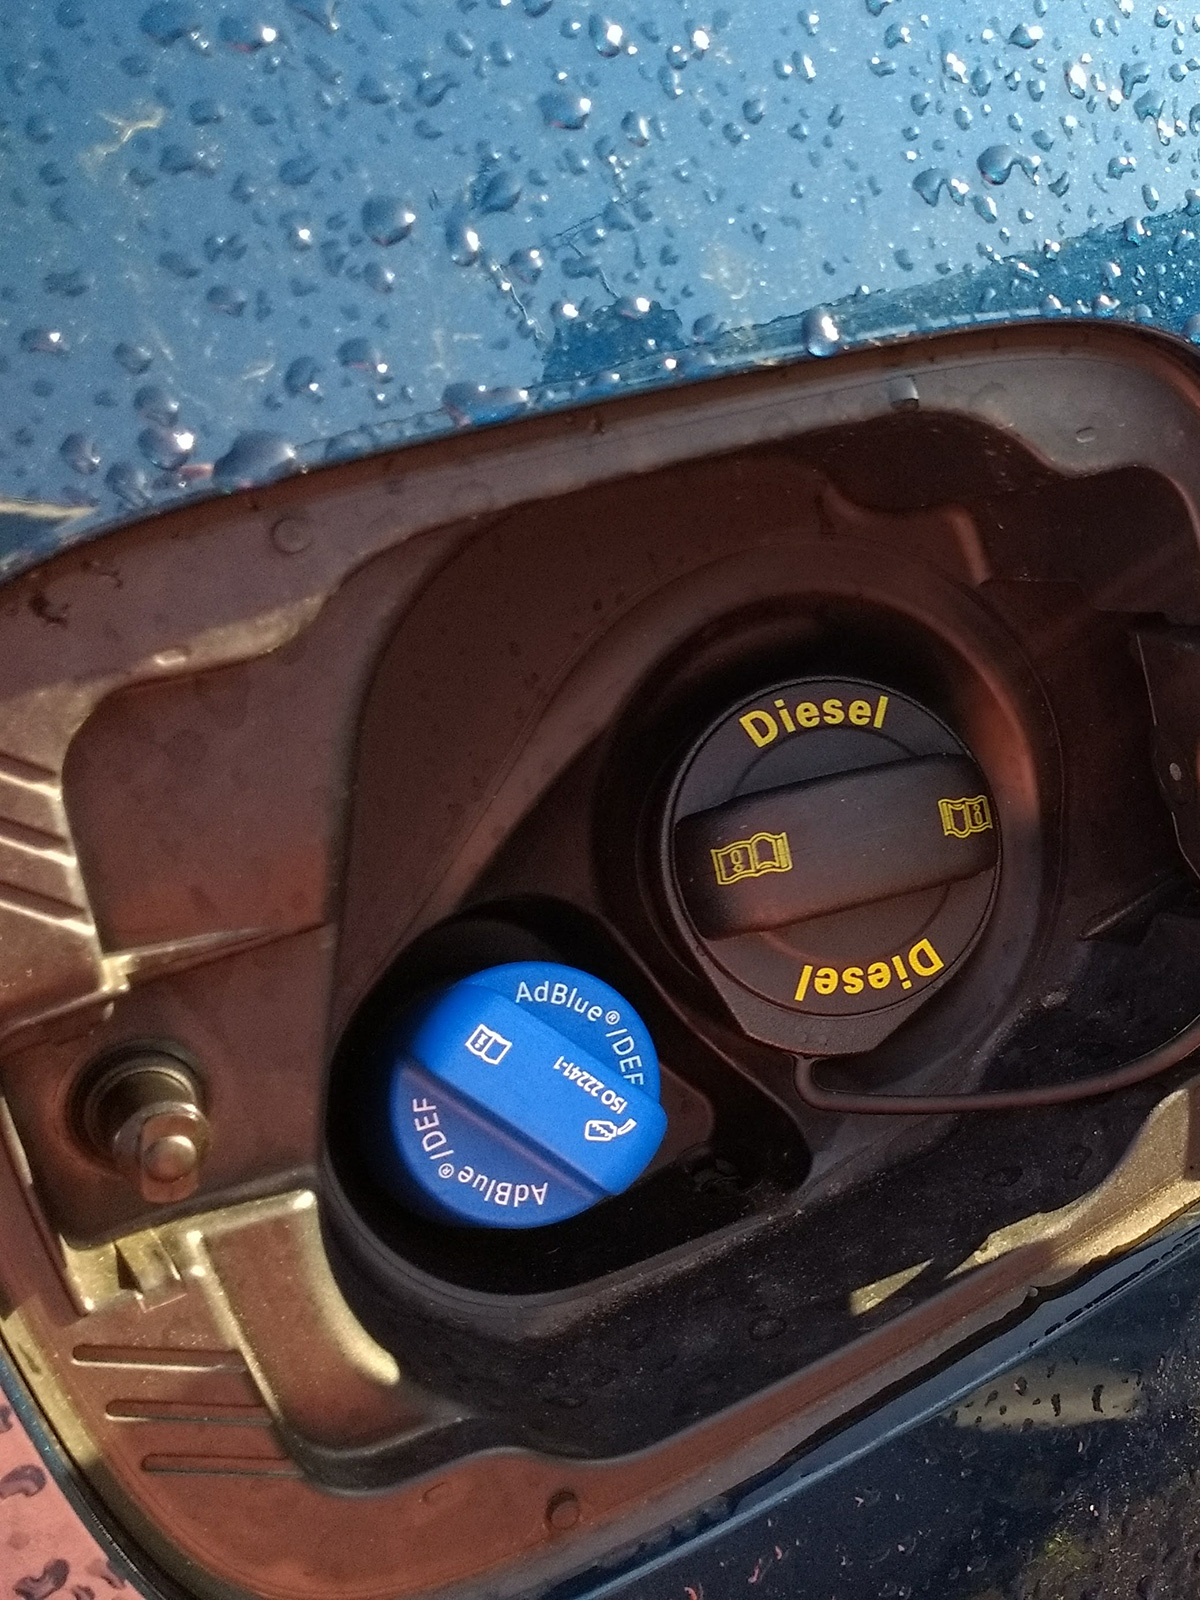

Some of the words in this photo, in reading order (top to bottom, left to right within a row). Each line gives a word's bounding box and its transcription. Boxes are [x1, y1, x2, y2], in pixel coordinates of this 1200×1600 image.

[739, 695, 889, 748] Diesel
[794, 938, 945, 1001] Diesel
[553, 1055, 606, 1097] 22241-1
[600, 1089, 628, 1115] ISO
